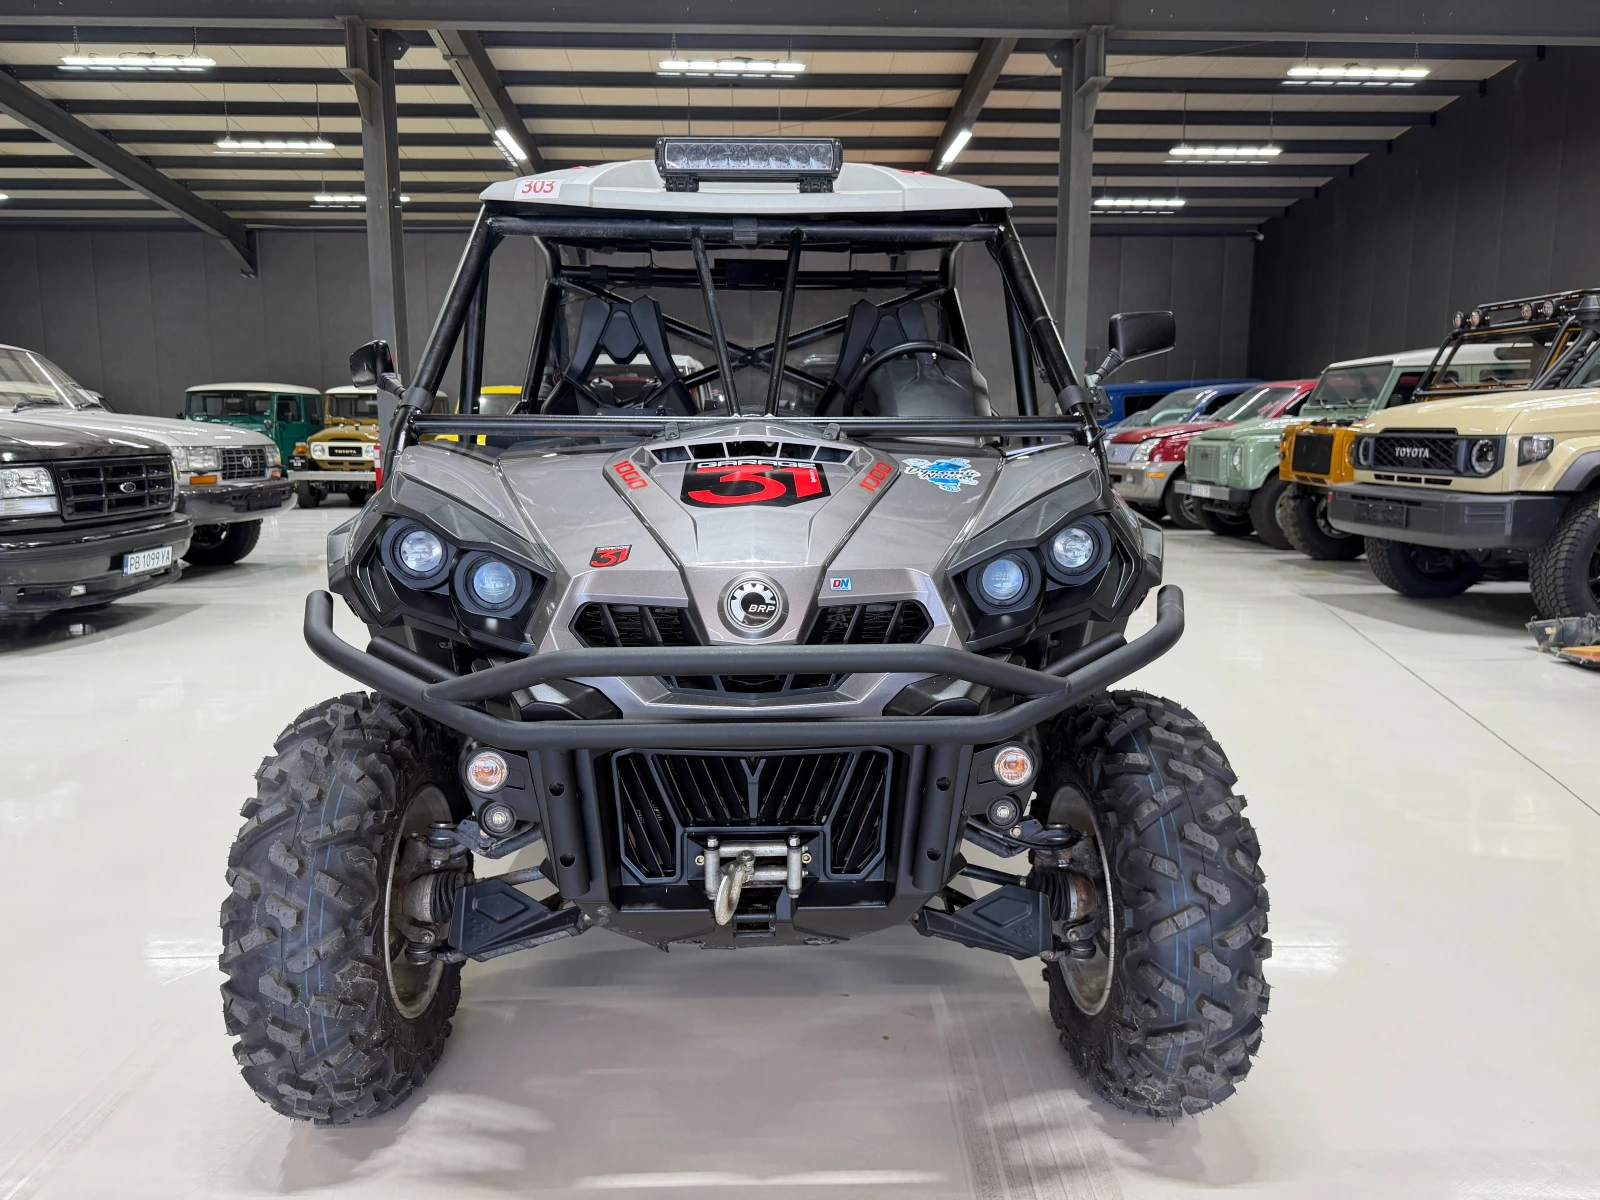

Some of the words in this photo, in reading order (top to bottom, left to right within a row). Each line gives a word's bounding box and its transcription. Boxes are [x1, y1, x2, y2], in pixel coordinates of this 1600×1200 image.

[521, 181, 555, 194] 303
[1395, 447, 1429, 459] TOYOTA
[697, 459, 816, 469] GARAGE
[613, 459, 648, 491] 1000
[858, 460, 893, 493] 1000
[687, 464, 823, 505] 31
[129, 555, 140, 571] PB
[142, 551, 160, 569] 1099
[590, 548, 630, 566] 31
[832, 578, 850, 588] DN
[748, 604, 775, 613] BRP
